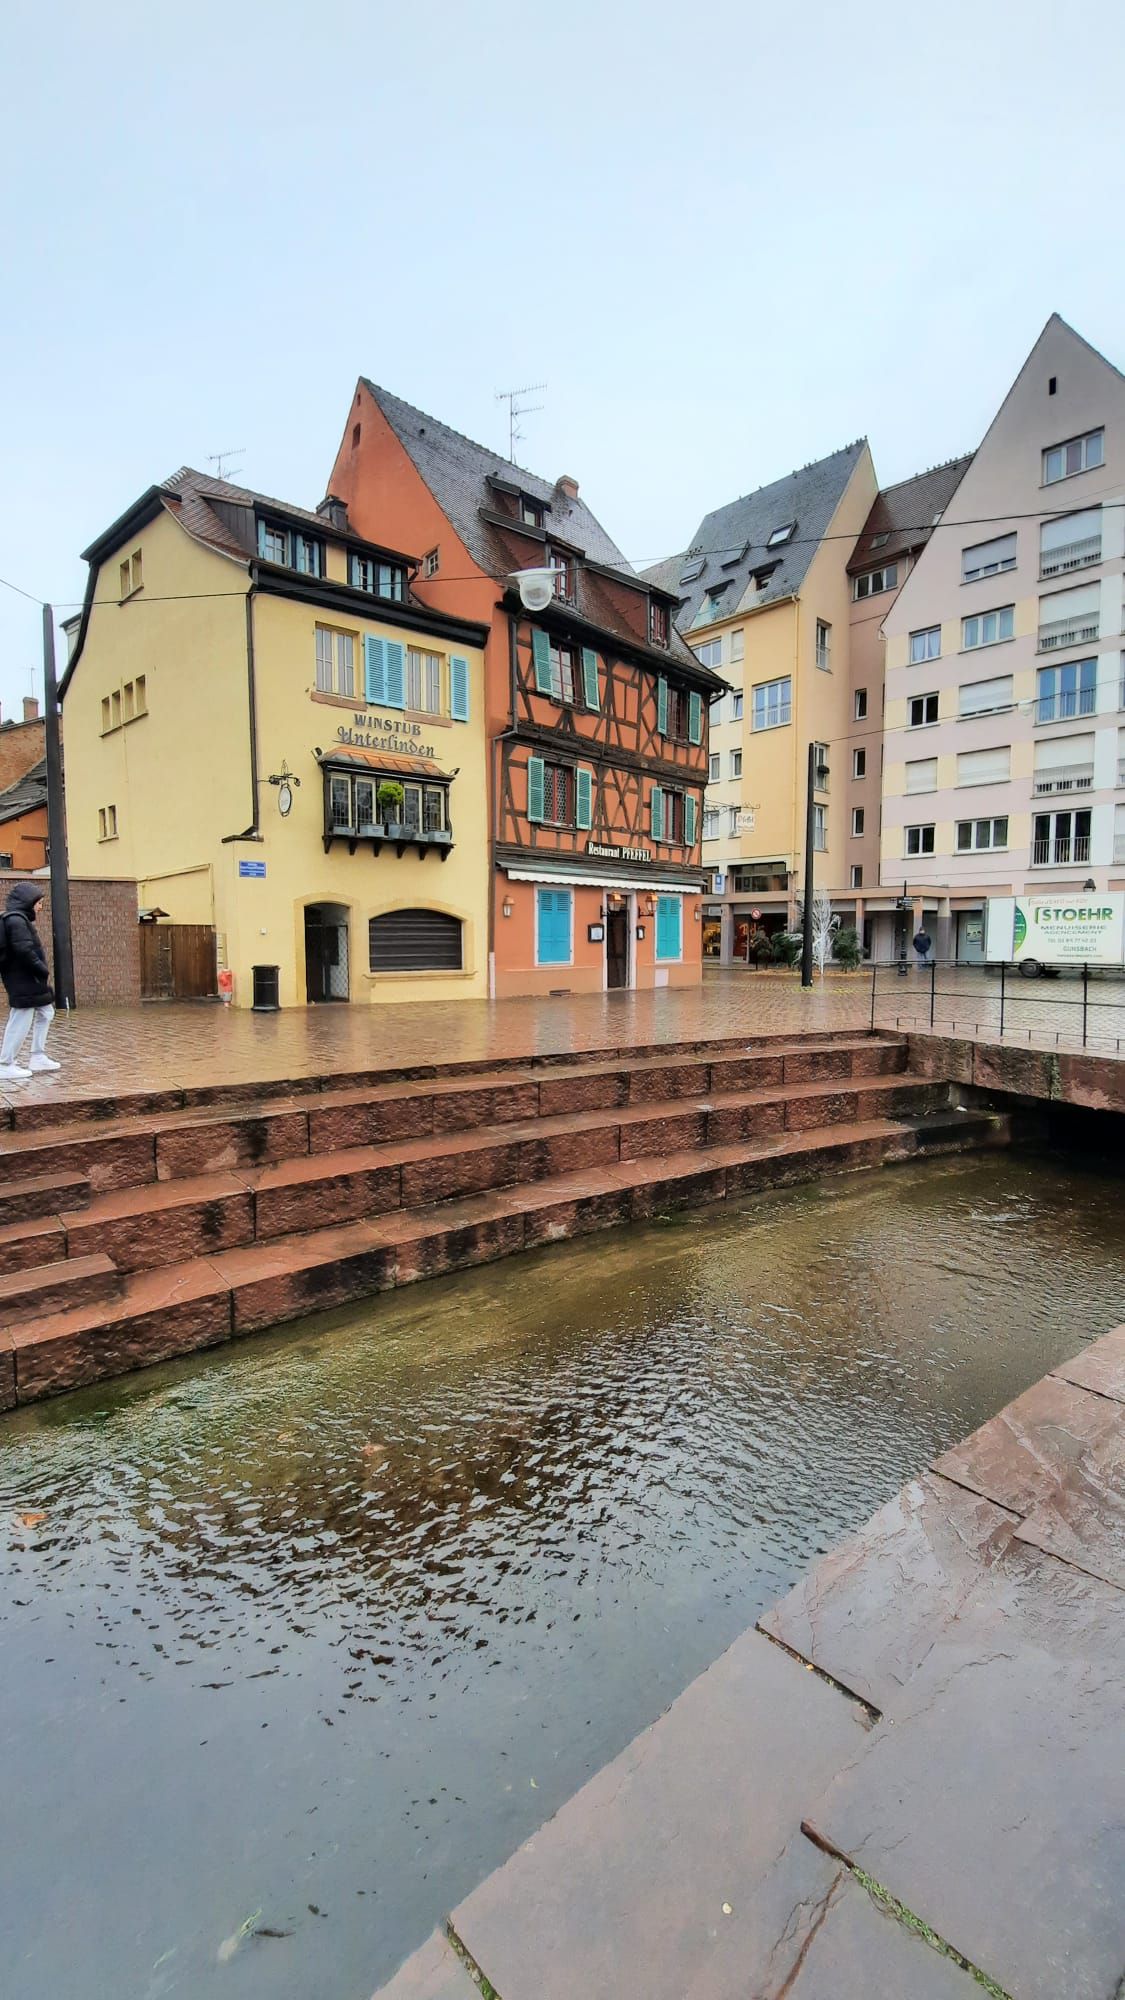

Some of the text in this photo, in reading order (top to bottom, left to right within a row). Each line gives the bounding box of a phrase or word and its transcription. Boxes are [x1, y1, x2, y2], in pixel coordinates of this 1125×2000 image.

[354, 713, 421, 736] WINSTUB
[337, 726, 434, 757] Unterlinden
[588, 841, 652, 862] Restaurant PFEFFEL
[1042, 908, 1113, 921] STOEHR
